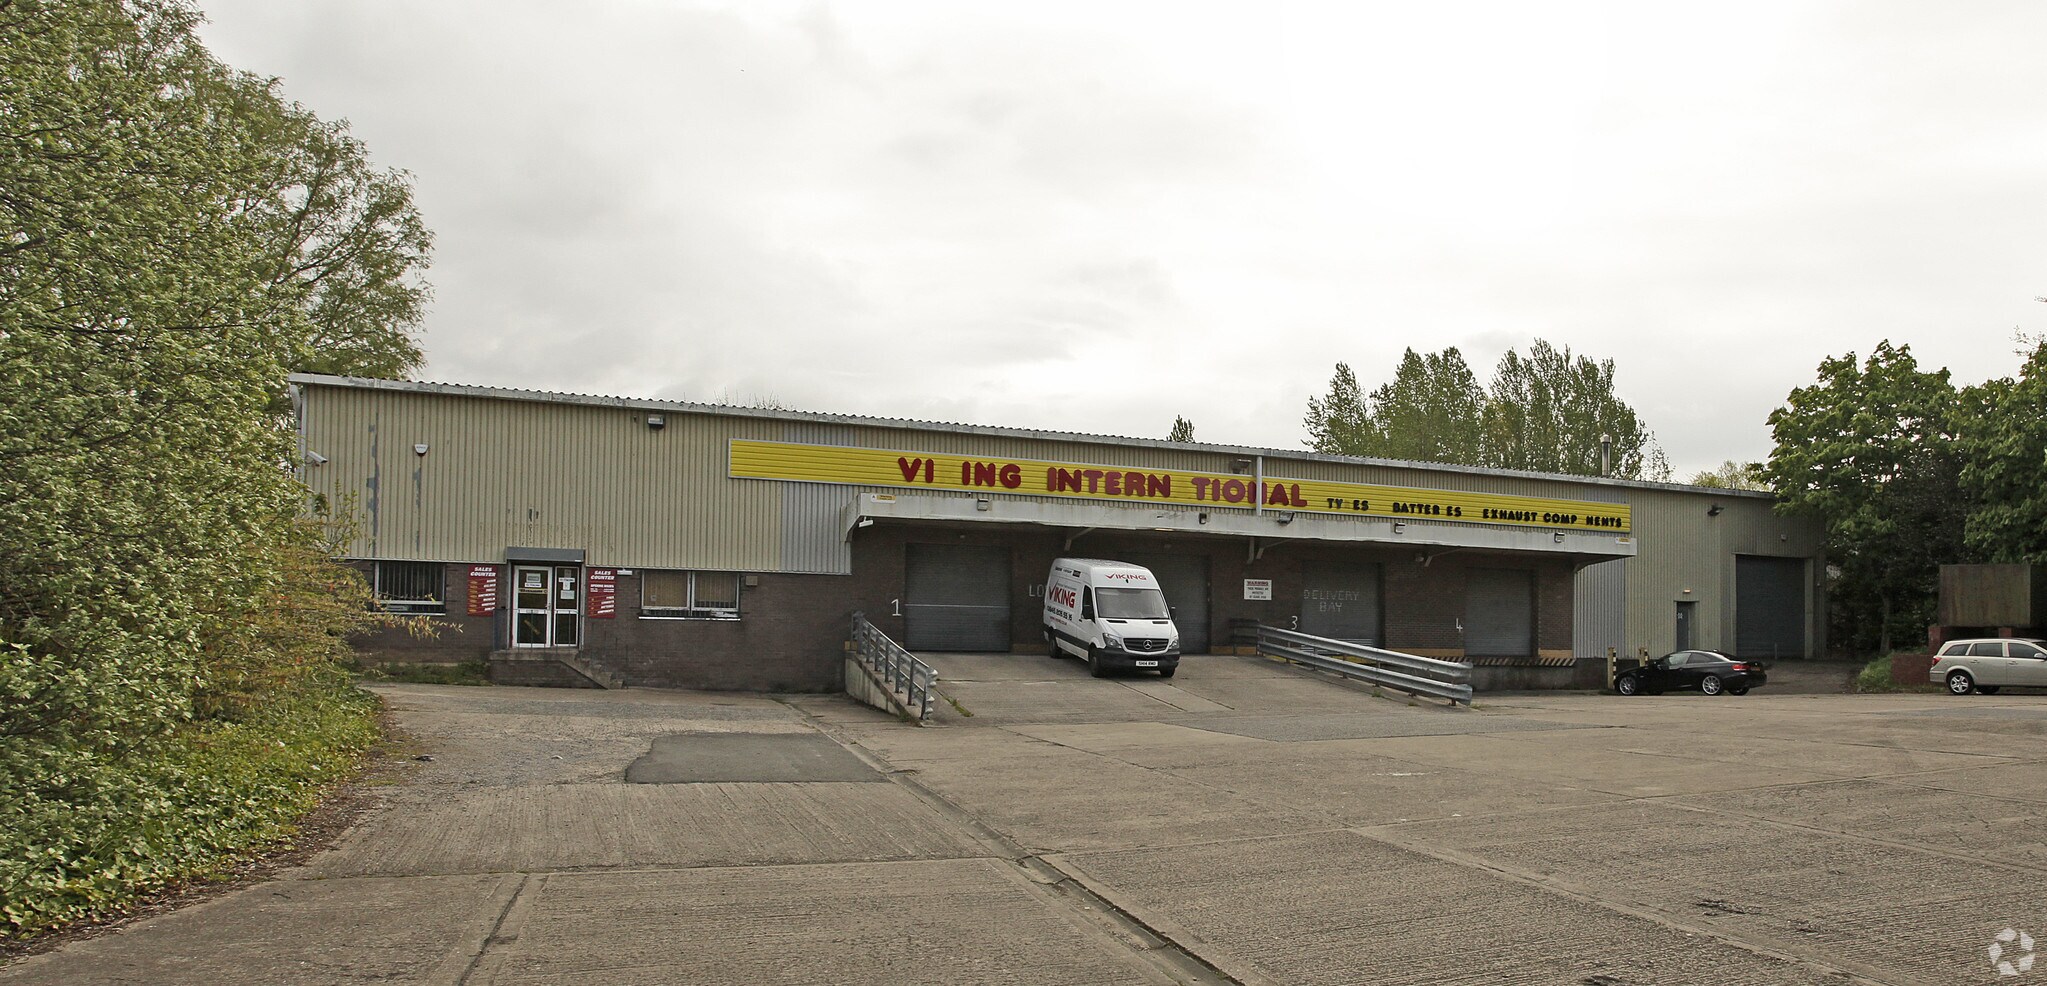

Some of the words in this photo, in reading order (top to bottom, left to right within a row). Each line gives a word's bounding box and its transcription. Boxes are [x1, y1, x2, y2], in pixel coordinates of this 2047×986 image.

[1482, 508, 1538, 522] EXHAUST
[1049, 579, 1077, 608] VIKING
[1303, 589, 1360, 601] DELIVERY
[891, 598, 902, 616] 1
[1319, 601, 1343, 613] BAY
[1291, 615, 1298, 630] 3
[1455, 617, 1463, 632] 4
